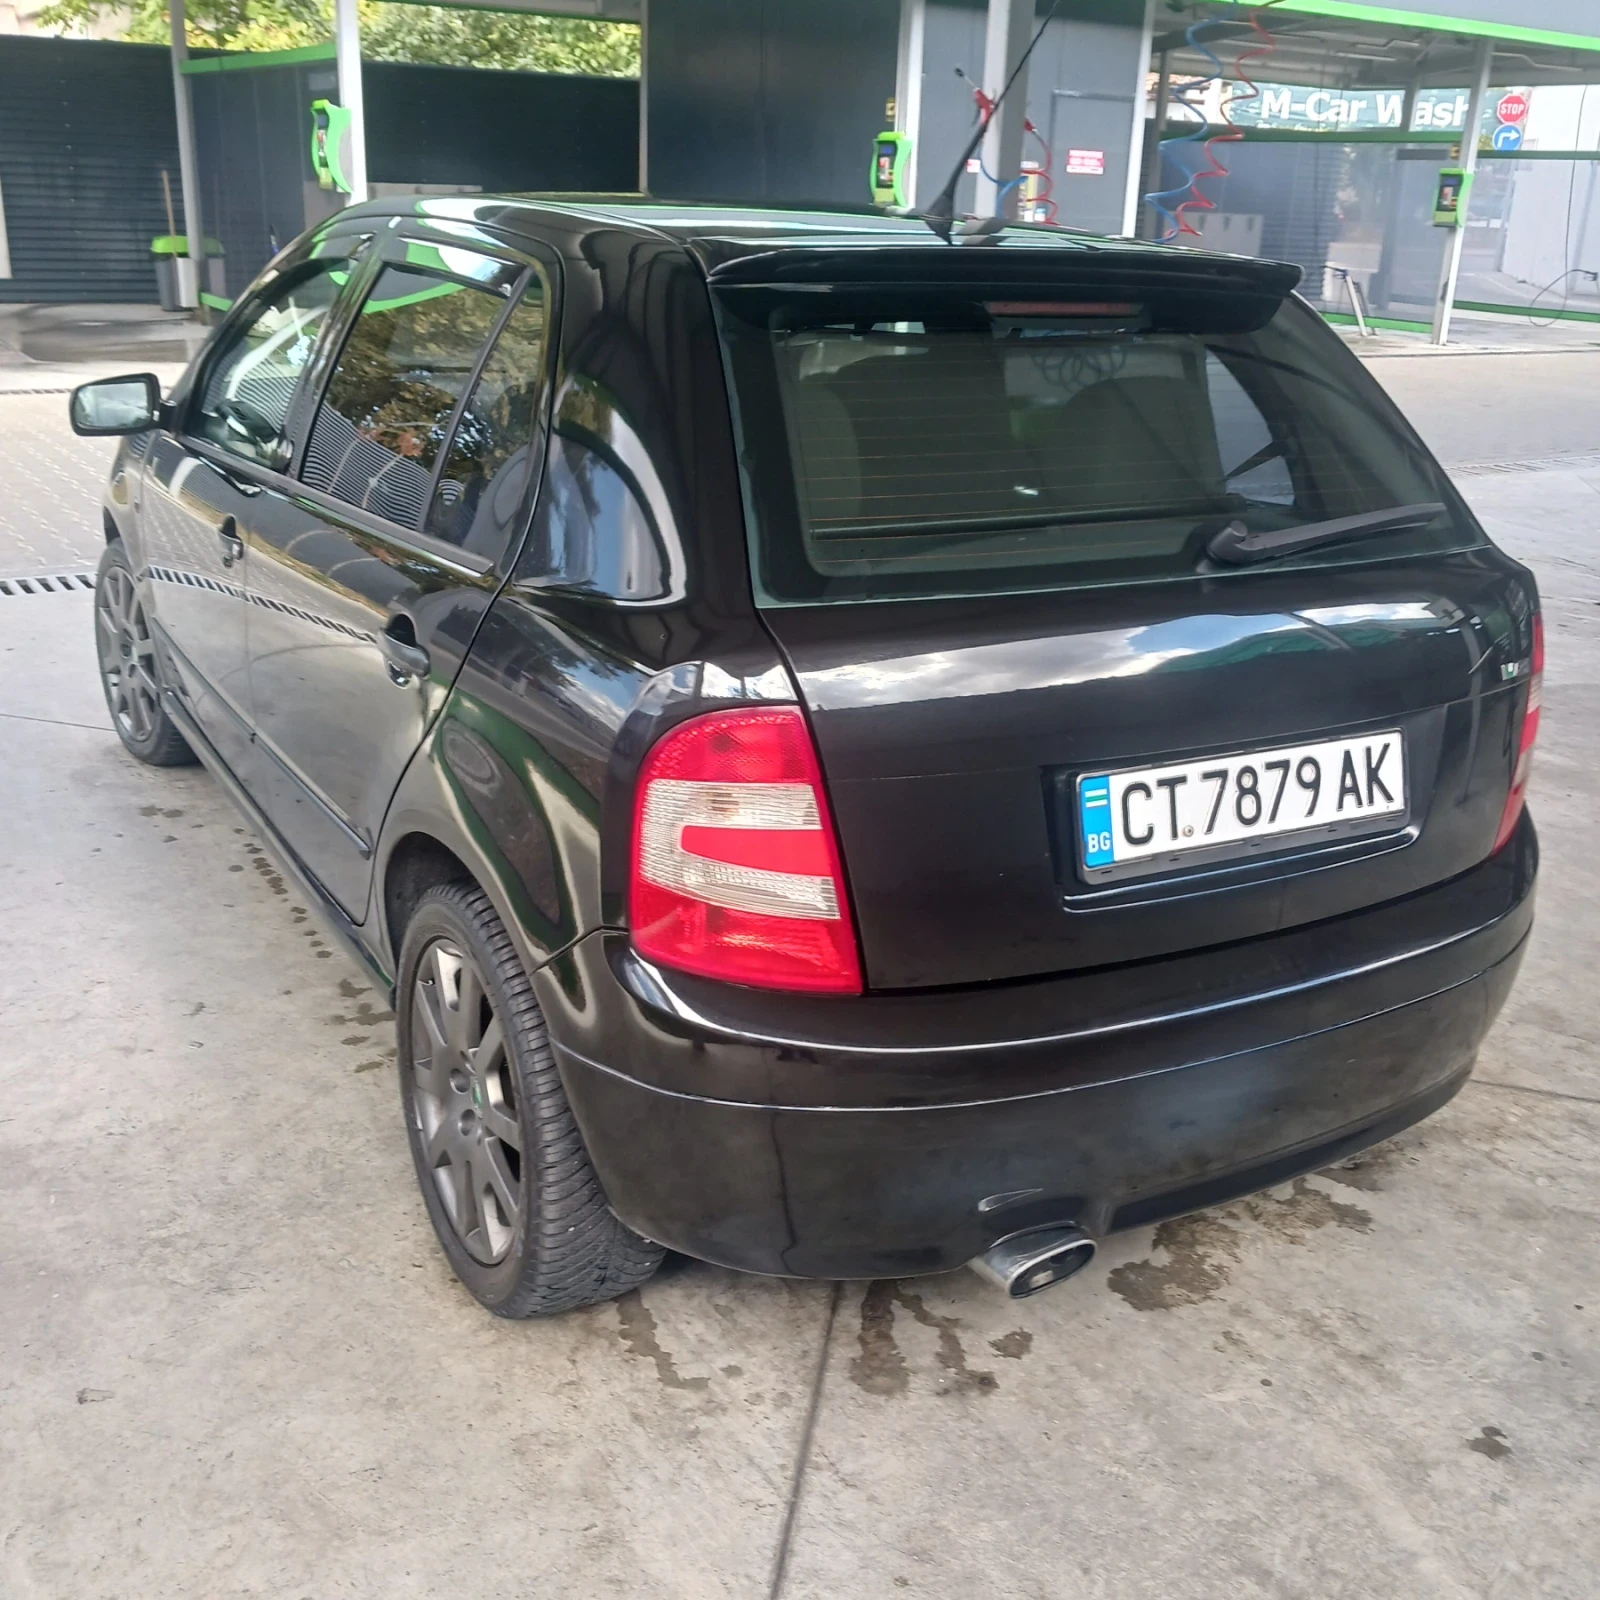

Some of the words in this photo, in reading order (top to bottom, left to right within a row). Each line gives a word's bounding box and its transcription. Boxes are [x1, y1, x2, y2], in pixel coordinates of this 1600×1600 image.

[1261, 90, 1367, 122] M-Car
[1500, 103, 1525, 115] STOP
[1202, 756, 1322, 834] 7879
[1336, 742, 1395, 810] AK
[1087, 831, 1111, 853] BG
